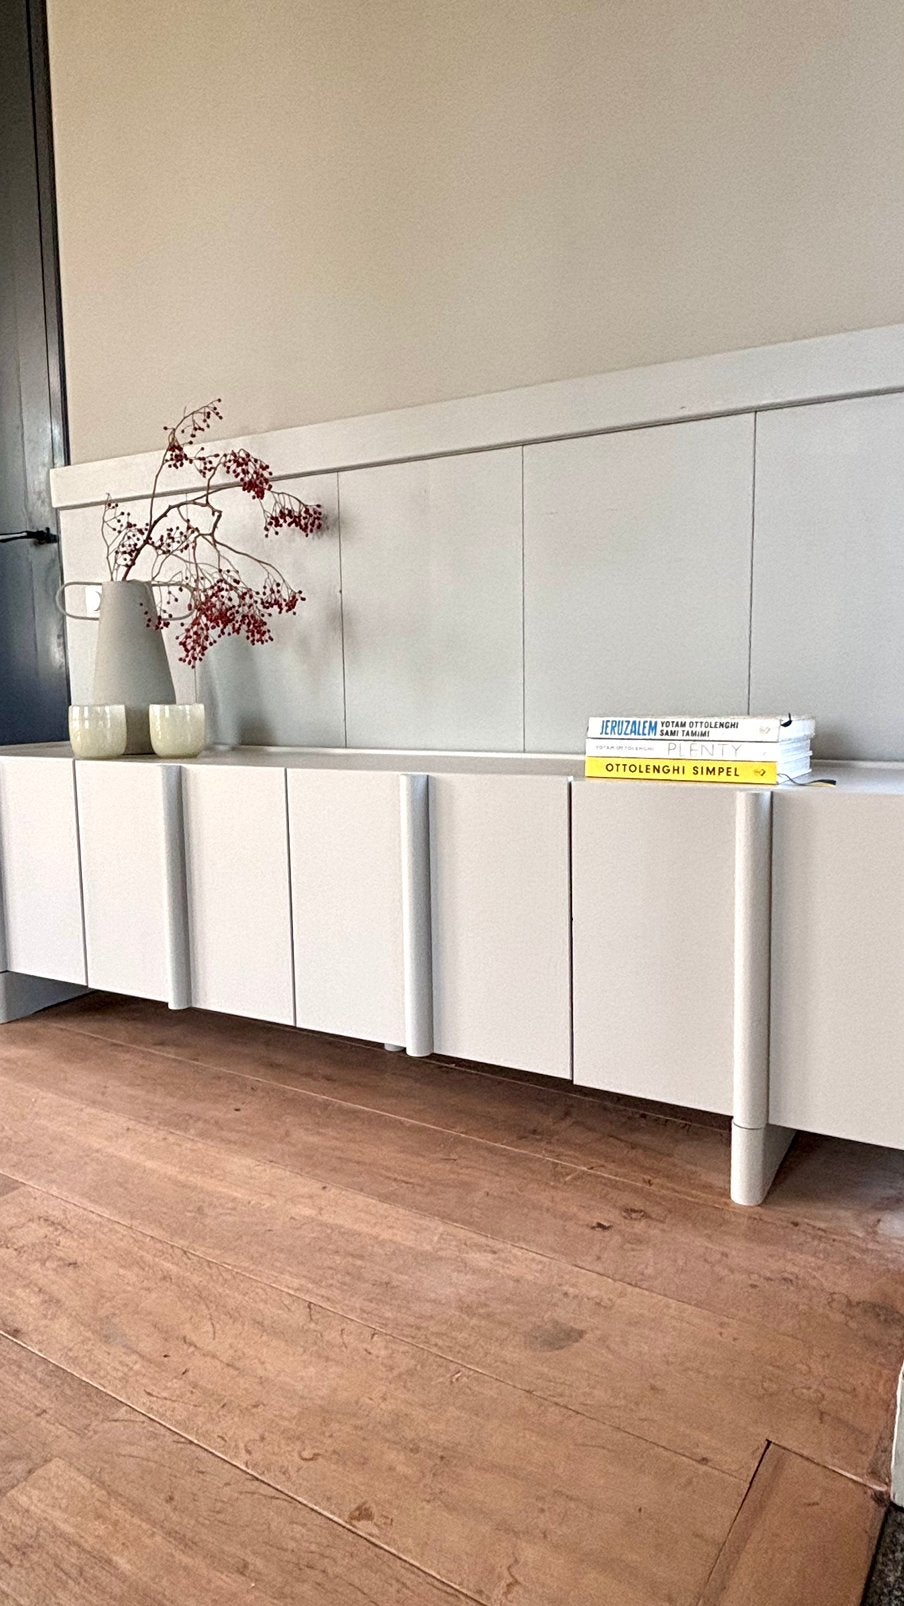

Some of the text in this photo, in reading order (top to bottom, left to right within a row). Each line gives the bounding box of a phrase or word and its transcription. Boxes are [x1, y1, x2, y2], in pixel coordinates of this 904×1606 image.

[600, 719, 658, 736] JERUZALEM
[660, 720, 739, 729] YOTAM OTTOLENGHI
[659, 729, 710, 738] SAMI TAMIMI
[667, 742, 743, 757] PLENTY
[605, 762, 740, 777] OTTOLENGHI SIMPEL
